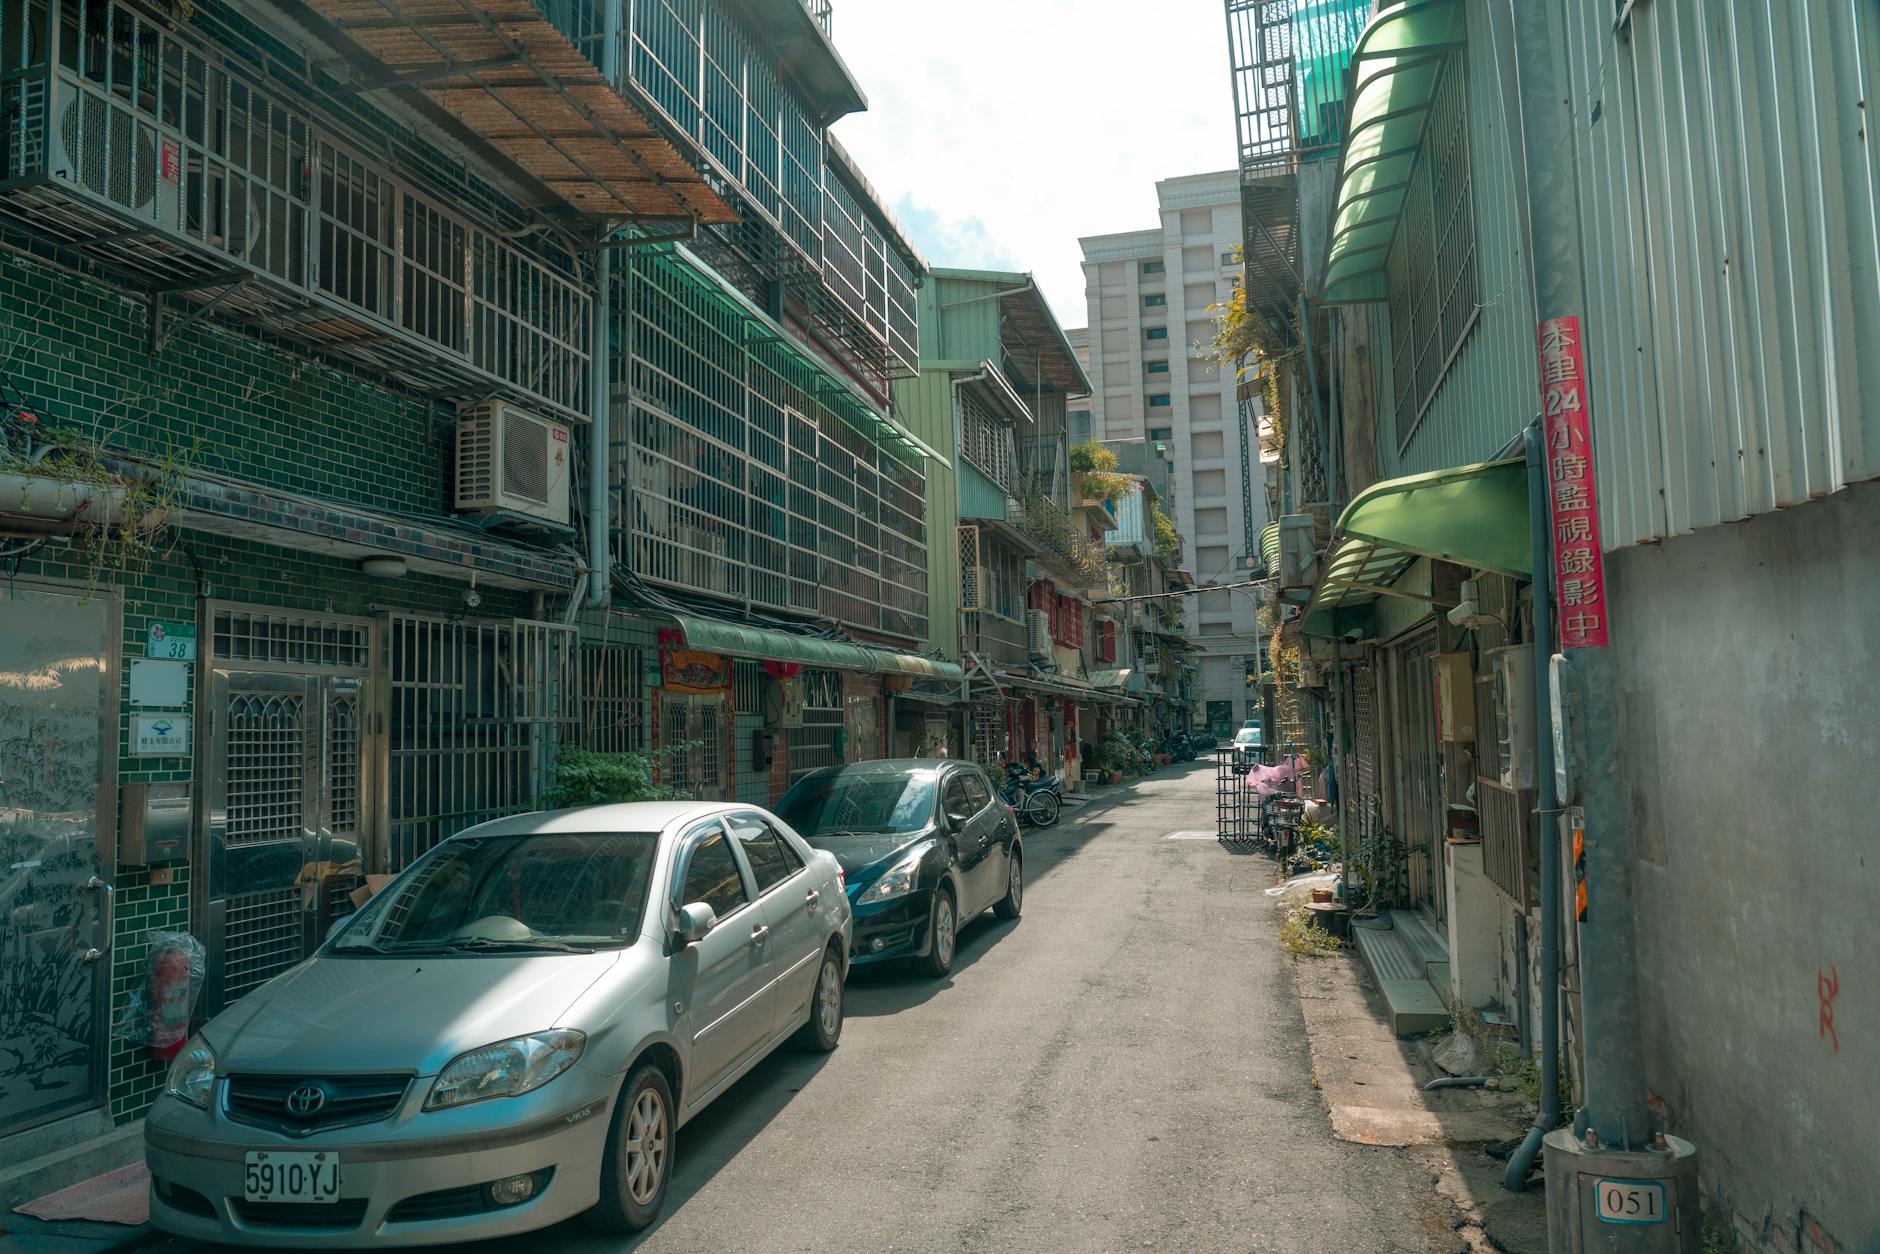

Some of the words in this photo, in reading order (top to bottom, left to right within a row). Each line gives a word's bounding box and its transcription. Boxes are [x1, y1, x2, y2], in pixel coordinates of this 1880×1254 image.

[1541, 323, 1601, 638] 本里24小時監視錄影中
[169, 643, 186, 657] 38
[565, 1106, 592, 1123] VIOS
[1607, 1188, 1656, 1216] 051
